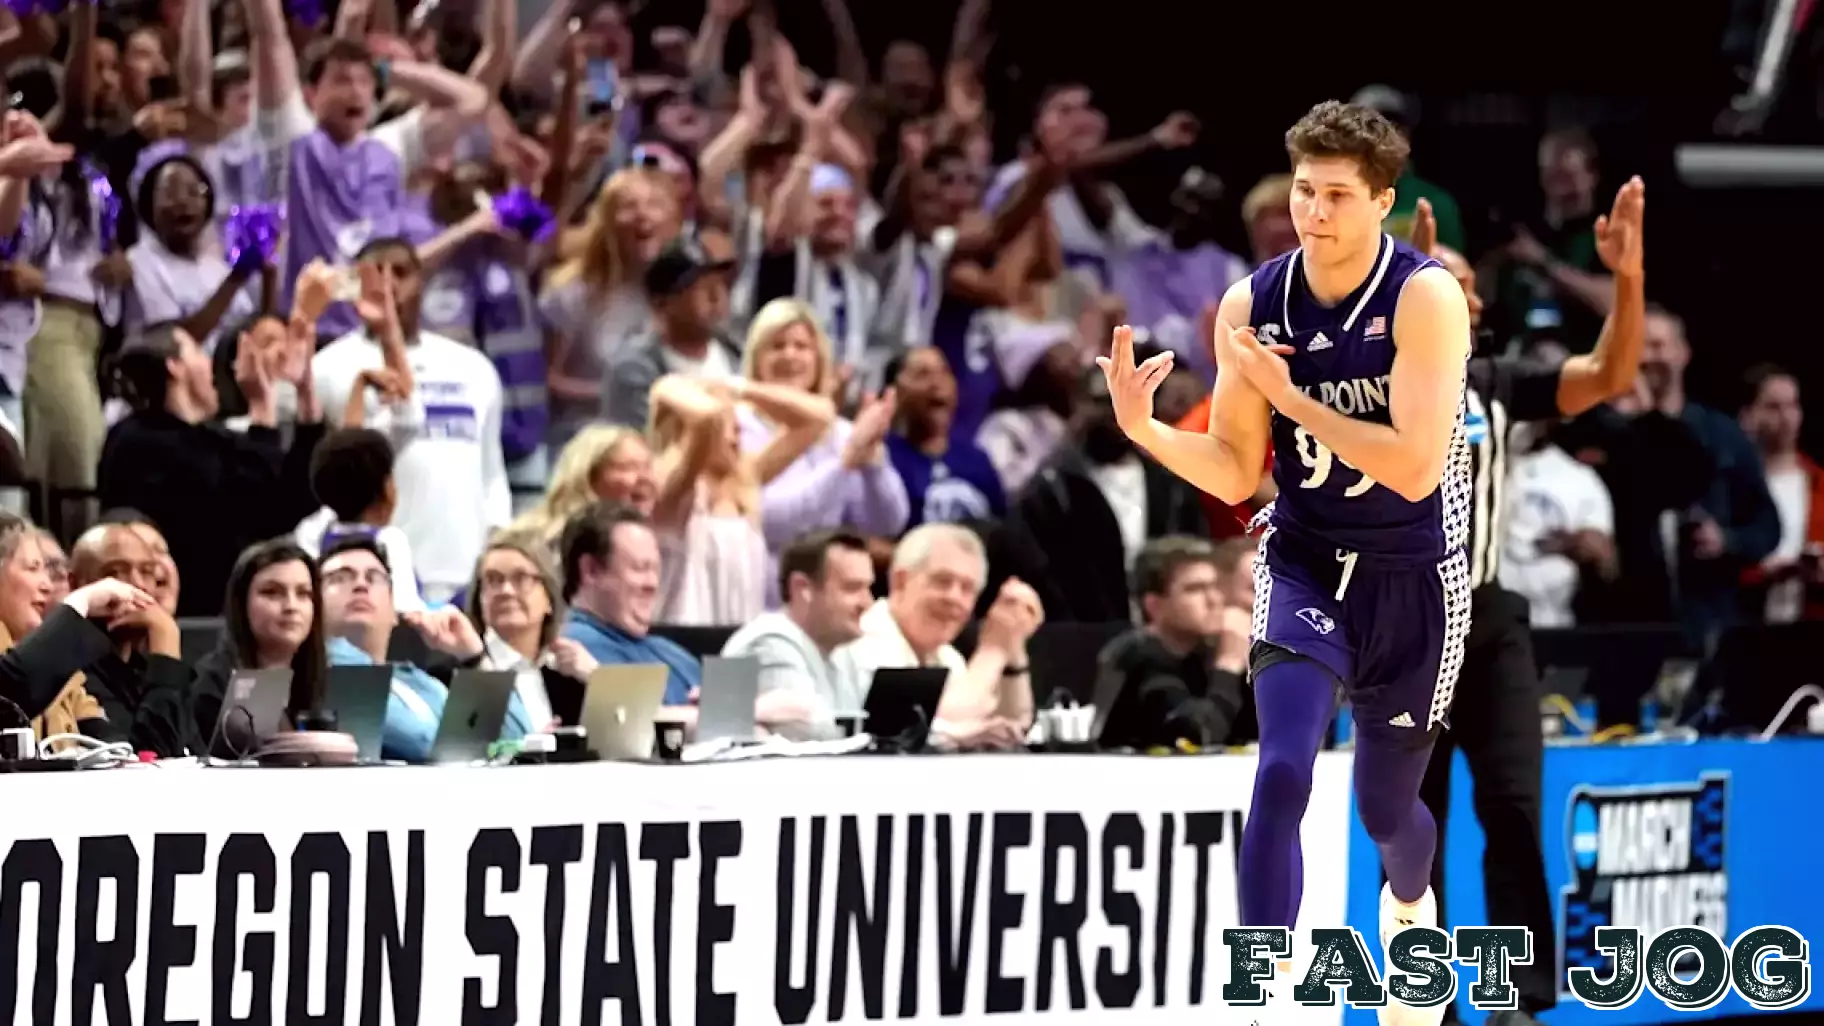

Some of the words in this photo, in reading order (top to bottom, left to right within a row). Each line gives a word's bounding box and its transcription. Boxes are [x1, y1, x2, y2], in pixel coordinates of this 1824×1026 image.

[1597, 797, 1693, 876] MARCH
[0, 829, 425, 1026] OREGON
[461, 820, 742, 1026] STATE
